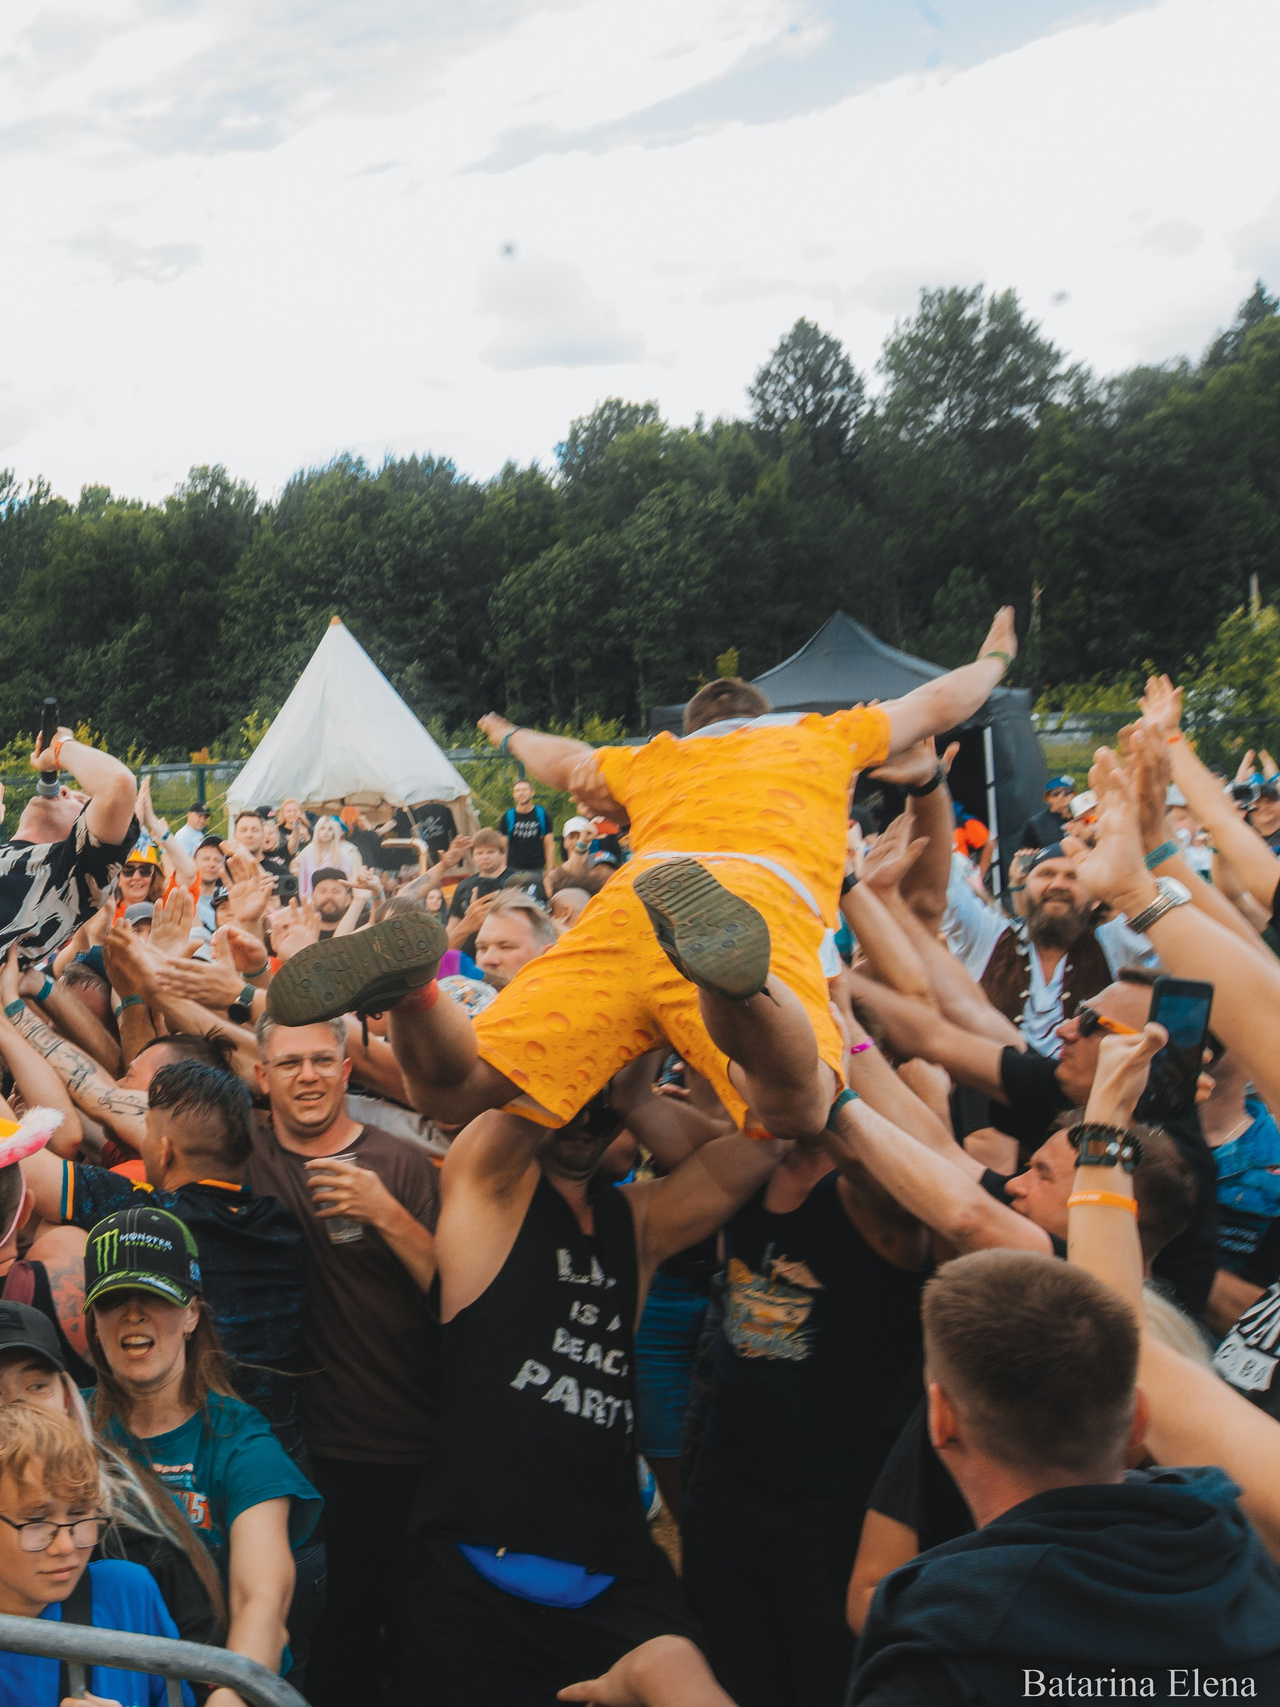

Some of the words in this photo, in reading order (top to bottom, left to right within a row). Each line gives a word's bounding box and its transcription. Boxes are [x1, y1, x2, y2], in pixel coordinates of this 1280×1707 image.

[119, 1231, 173, 1251] MONSTER
[570, 1300, 600, 1326] IS
[551, 1326, 629, 1377] BEAC
